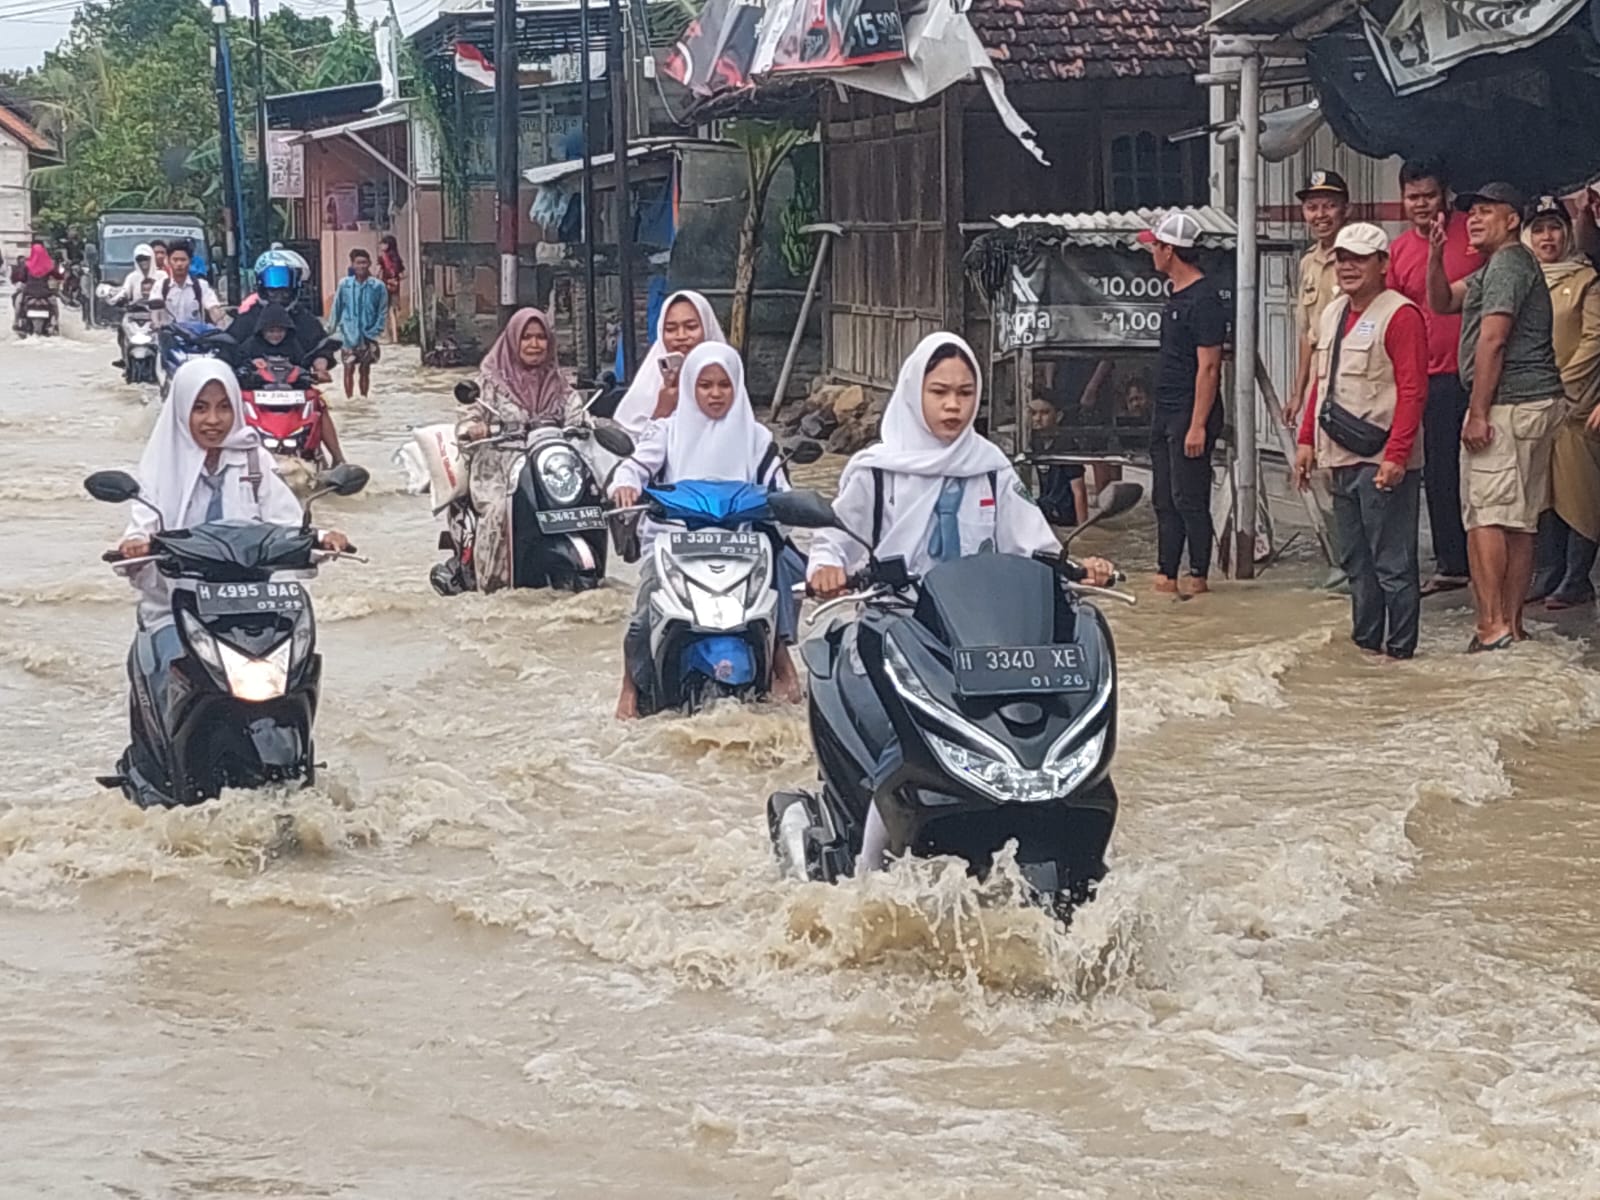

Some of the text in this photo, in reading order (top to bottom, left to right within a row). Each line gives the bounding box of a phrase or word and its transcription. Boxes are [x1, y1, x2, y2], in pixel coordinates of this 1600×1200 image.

[672, 533, 682, 544] H
[199, 585, 211, 600] H
[217, 584, 260, 598] 4995
[986, 650, 1035, 670] 3340
[1051, 649, 1078, 668] XE
